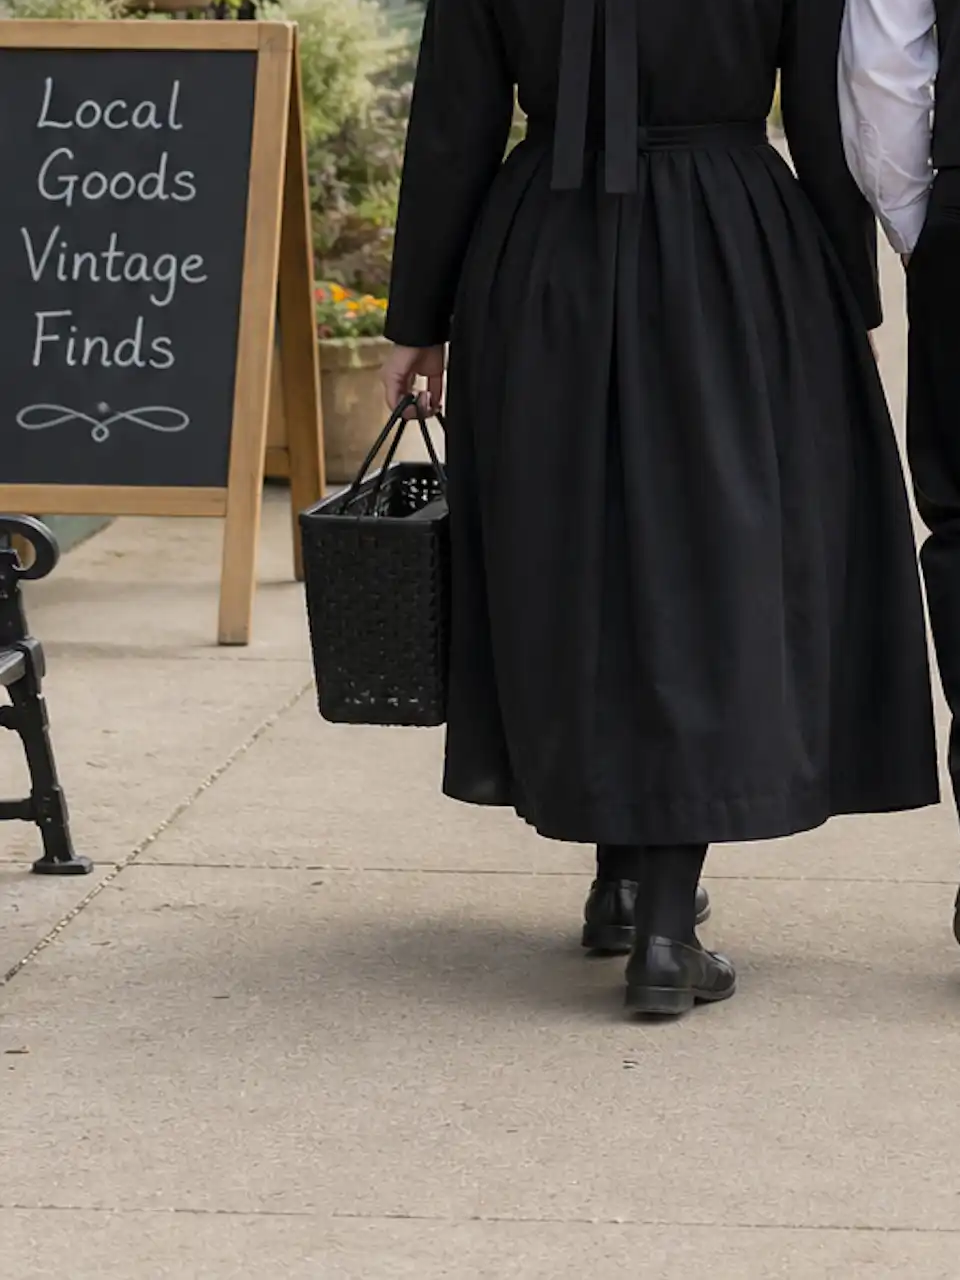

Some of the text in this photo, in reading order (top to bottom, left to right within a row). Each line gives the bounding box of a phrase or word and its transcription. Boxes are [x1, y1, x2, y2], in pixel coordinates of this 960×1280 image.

[36, 76, 183, 131] Local
[37, 147, 197, 207] Goods
[20, 225, 208, 307] Vintage
[32, 309, 175, 369] Finds
